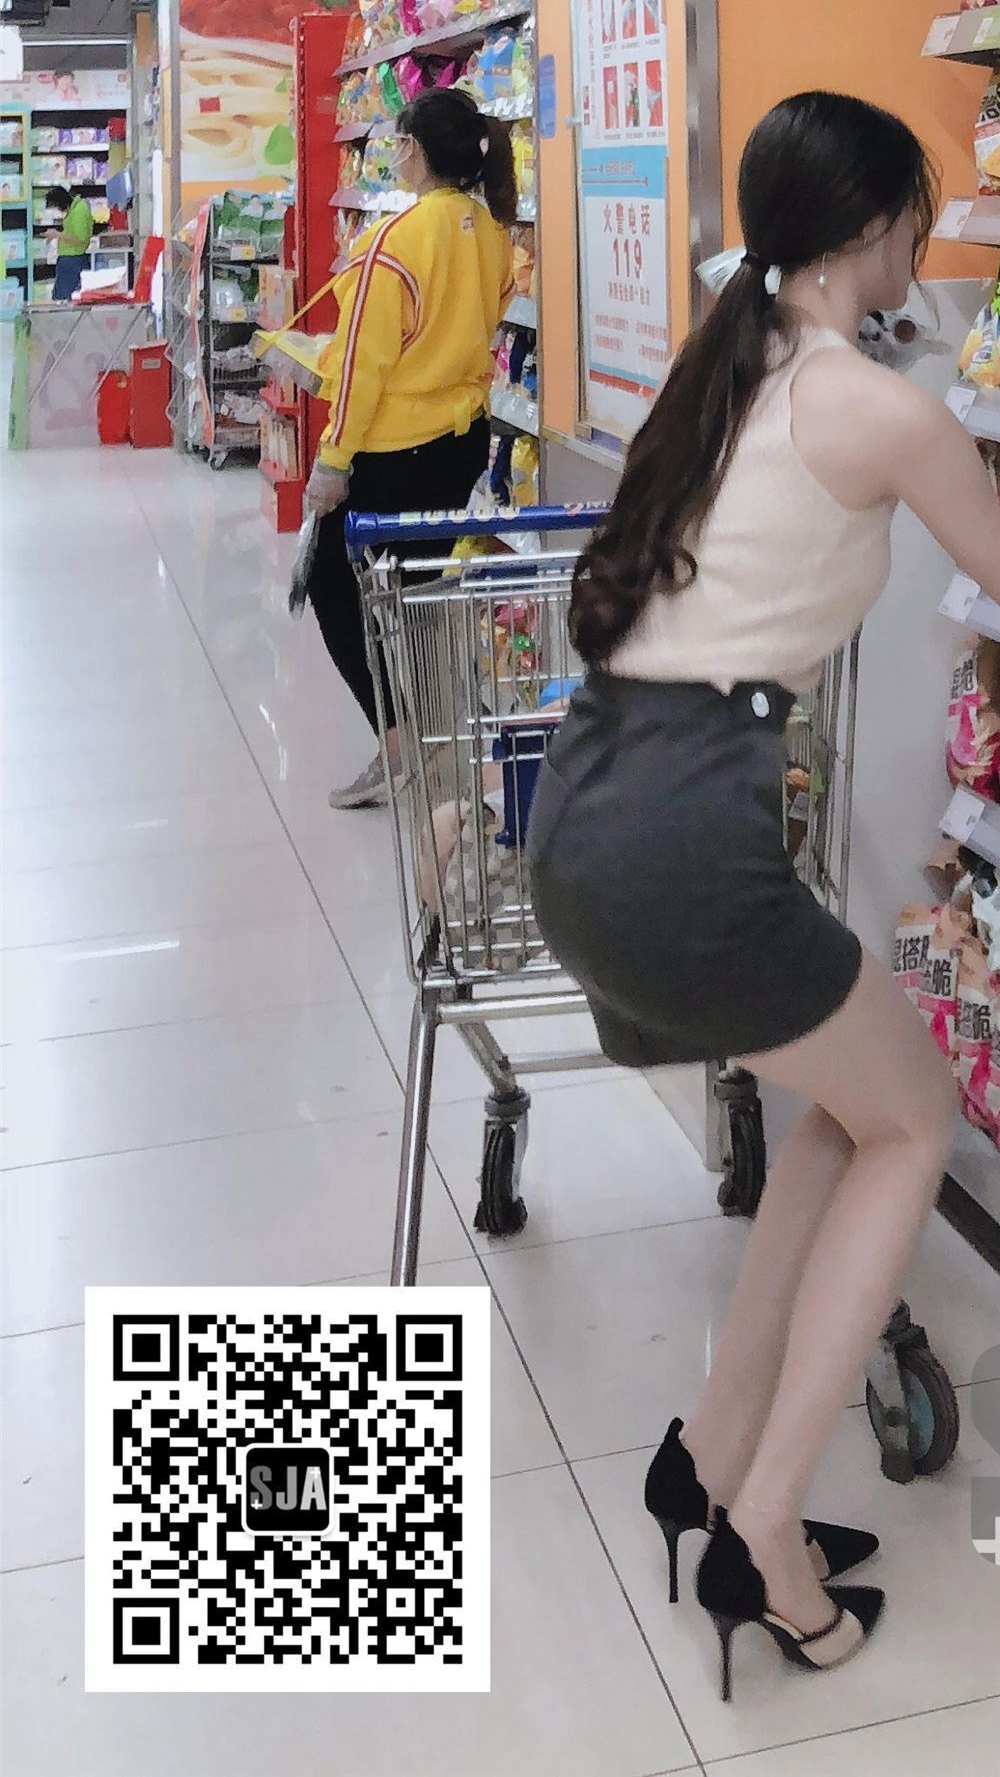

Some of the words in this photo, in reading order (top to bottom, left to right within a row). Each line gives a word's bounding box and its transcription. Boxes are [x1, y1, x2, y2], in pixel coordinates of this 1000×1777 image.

[603, 202, 651, 236] 火警电话
[612, 237, 642, 280] 119
